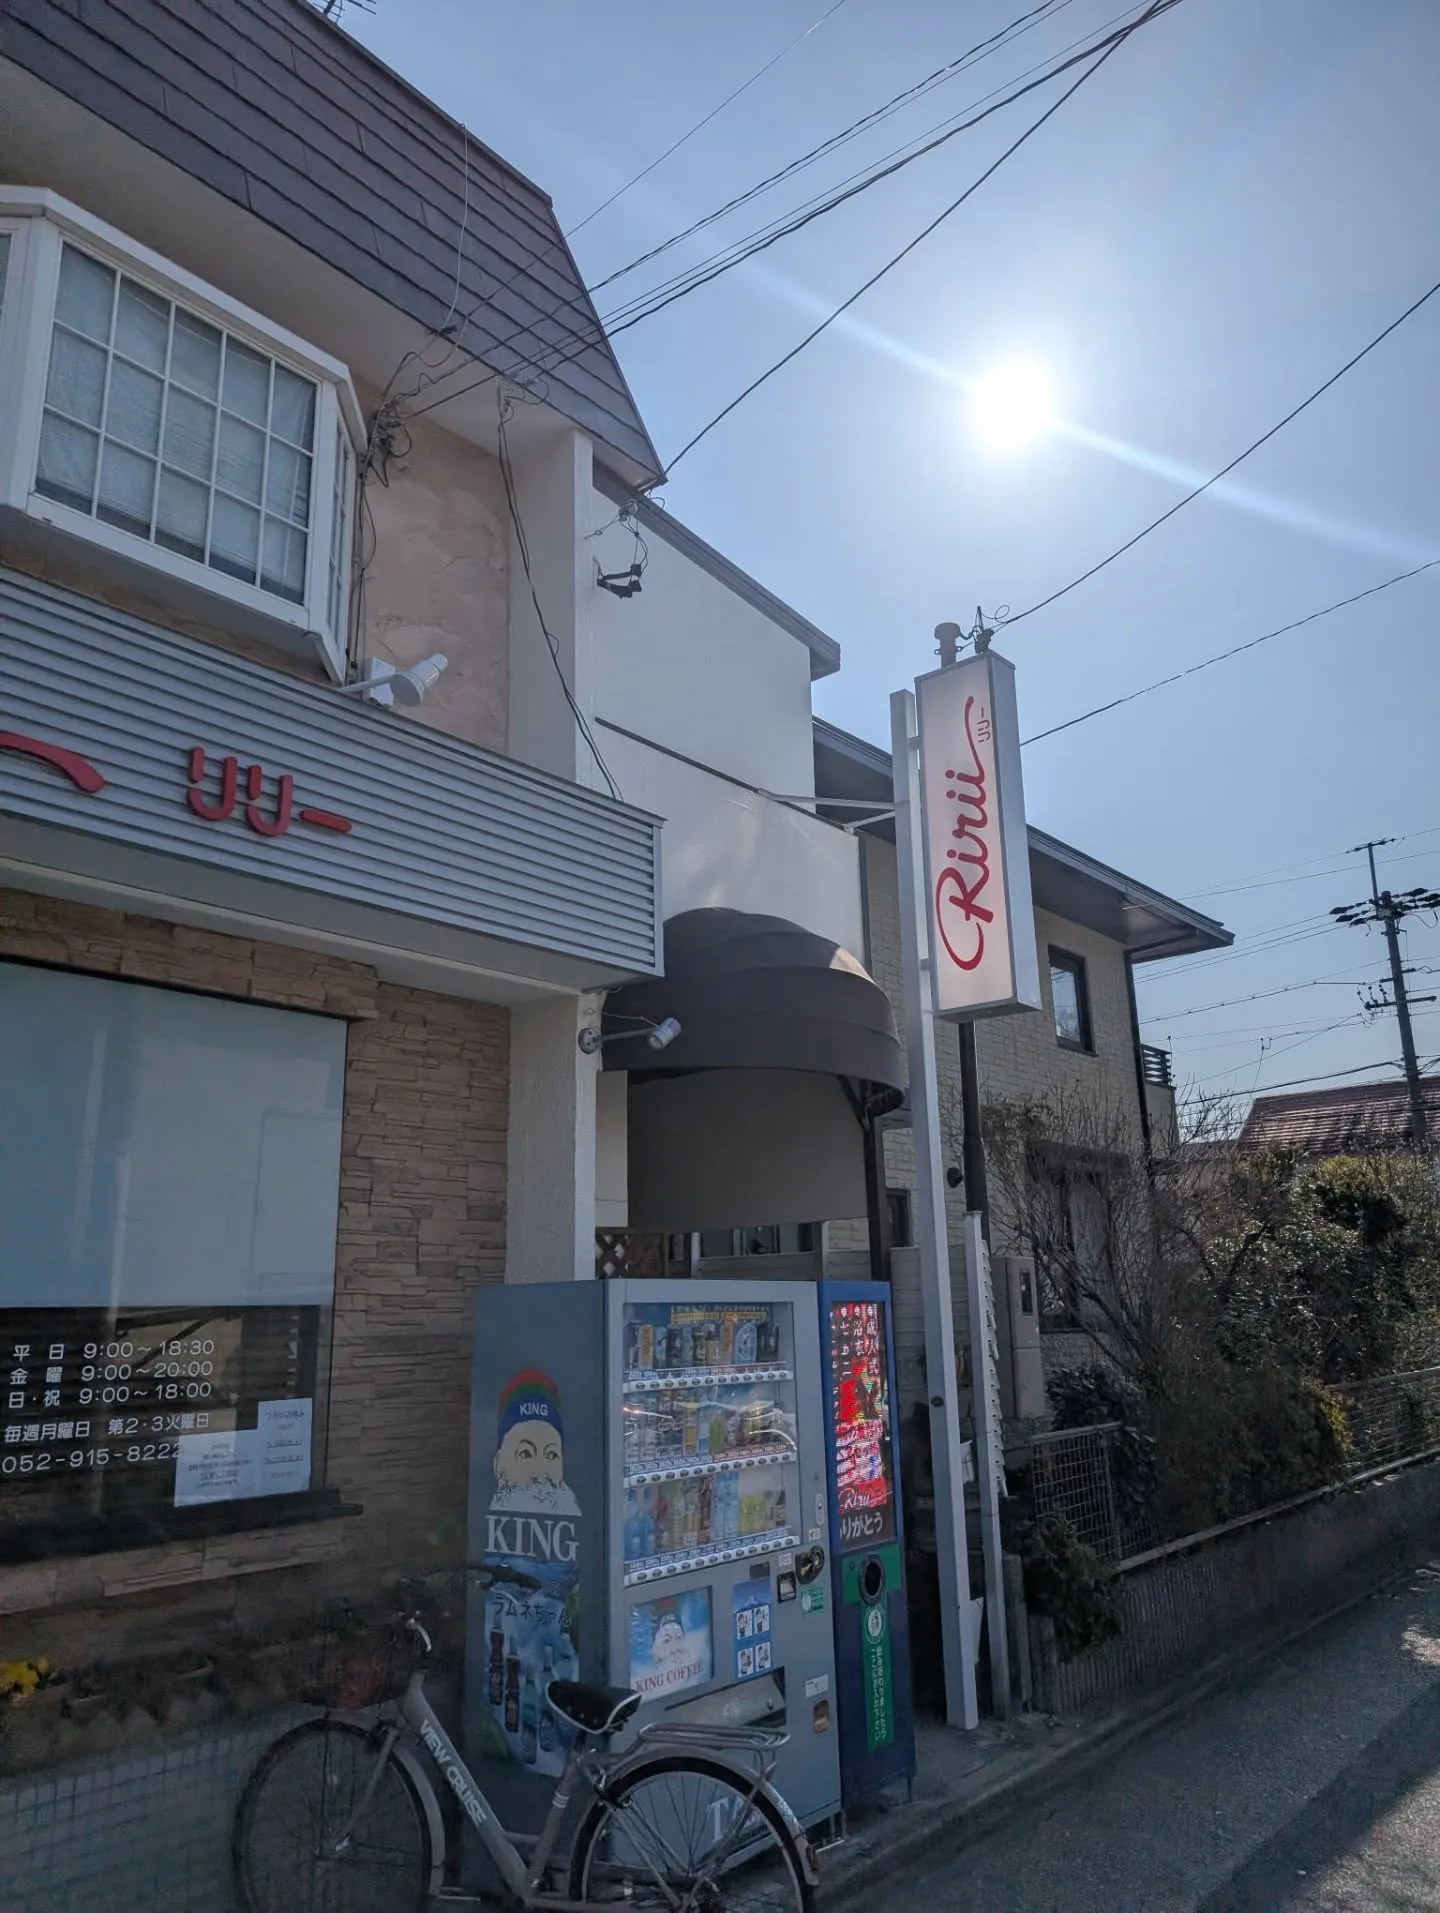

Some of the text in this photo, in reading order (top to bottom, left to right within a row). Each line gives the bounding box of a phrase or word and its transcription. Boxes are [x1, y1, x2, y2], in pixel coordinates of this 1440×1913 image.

[187, 746, 352, 837] リリー
[519, 1402, 549, 1416] KING
[4, 1421, 90, 1443] 毎週月曜日
[484, 1515, 580, 1563] KING
[840, 1512, 883, 1539] りがとう
[635, 1663, 705, 1693] KING COFFEE
